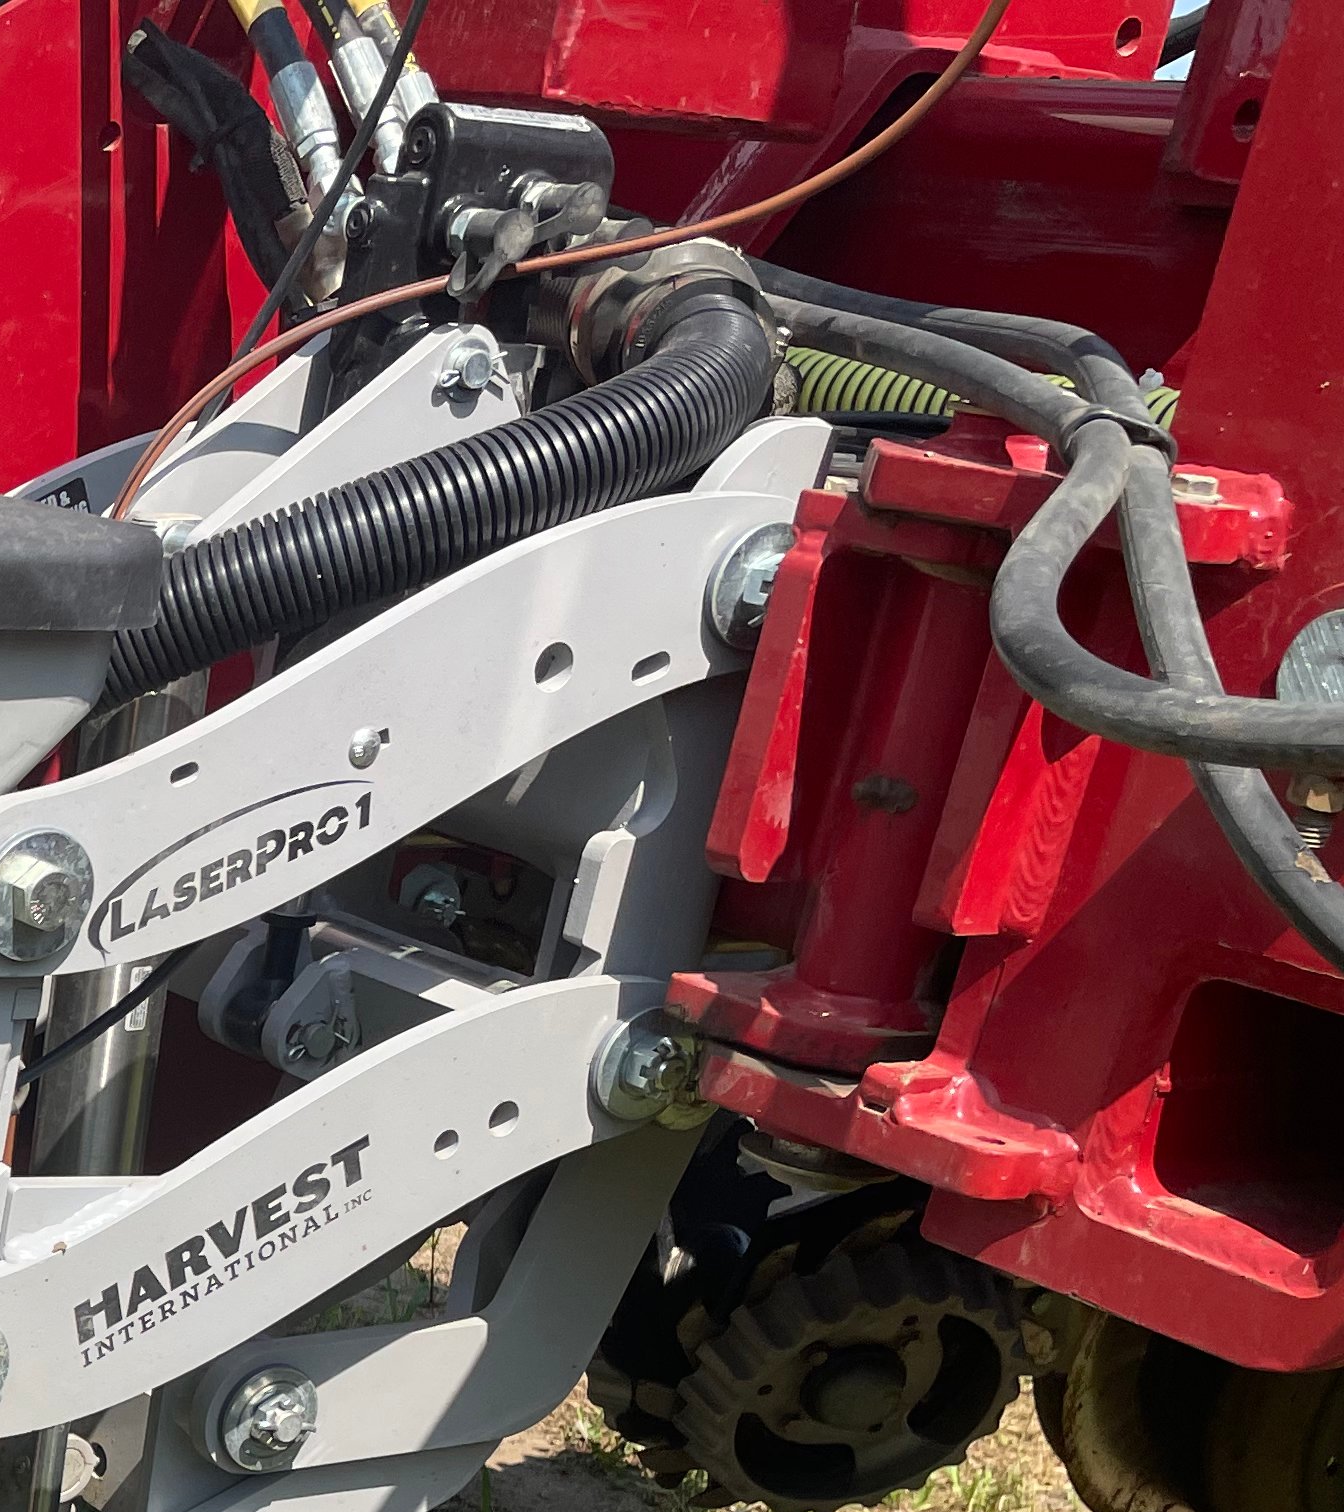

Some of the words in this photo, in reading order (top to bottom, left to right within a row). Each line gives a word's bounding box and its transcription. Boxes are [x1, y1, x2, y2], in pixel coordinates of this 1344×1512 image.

[73, 1133, 371, 1346] HARVEST
[80, 1203, 340, 1368] INTERNATIONAL
[343, 1188, 373, 1215] INC
